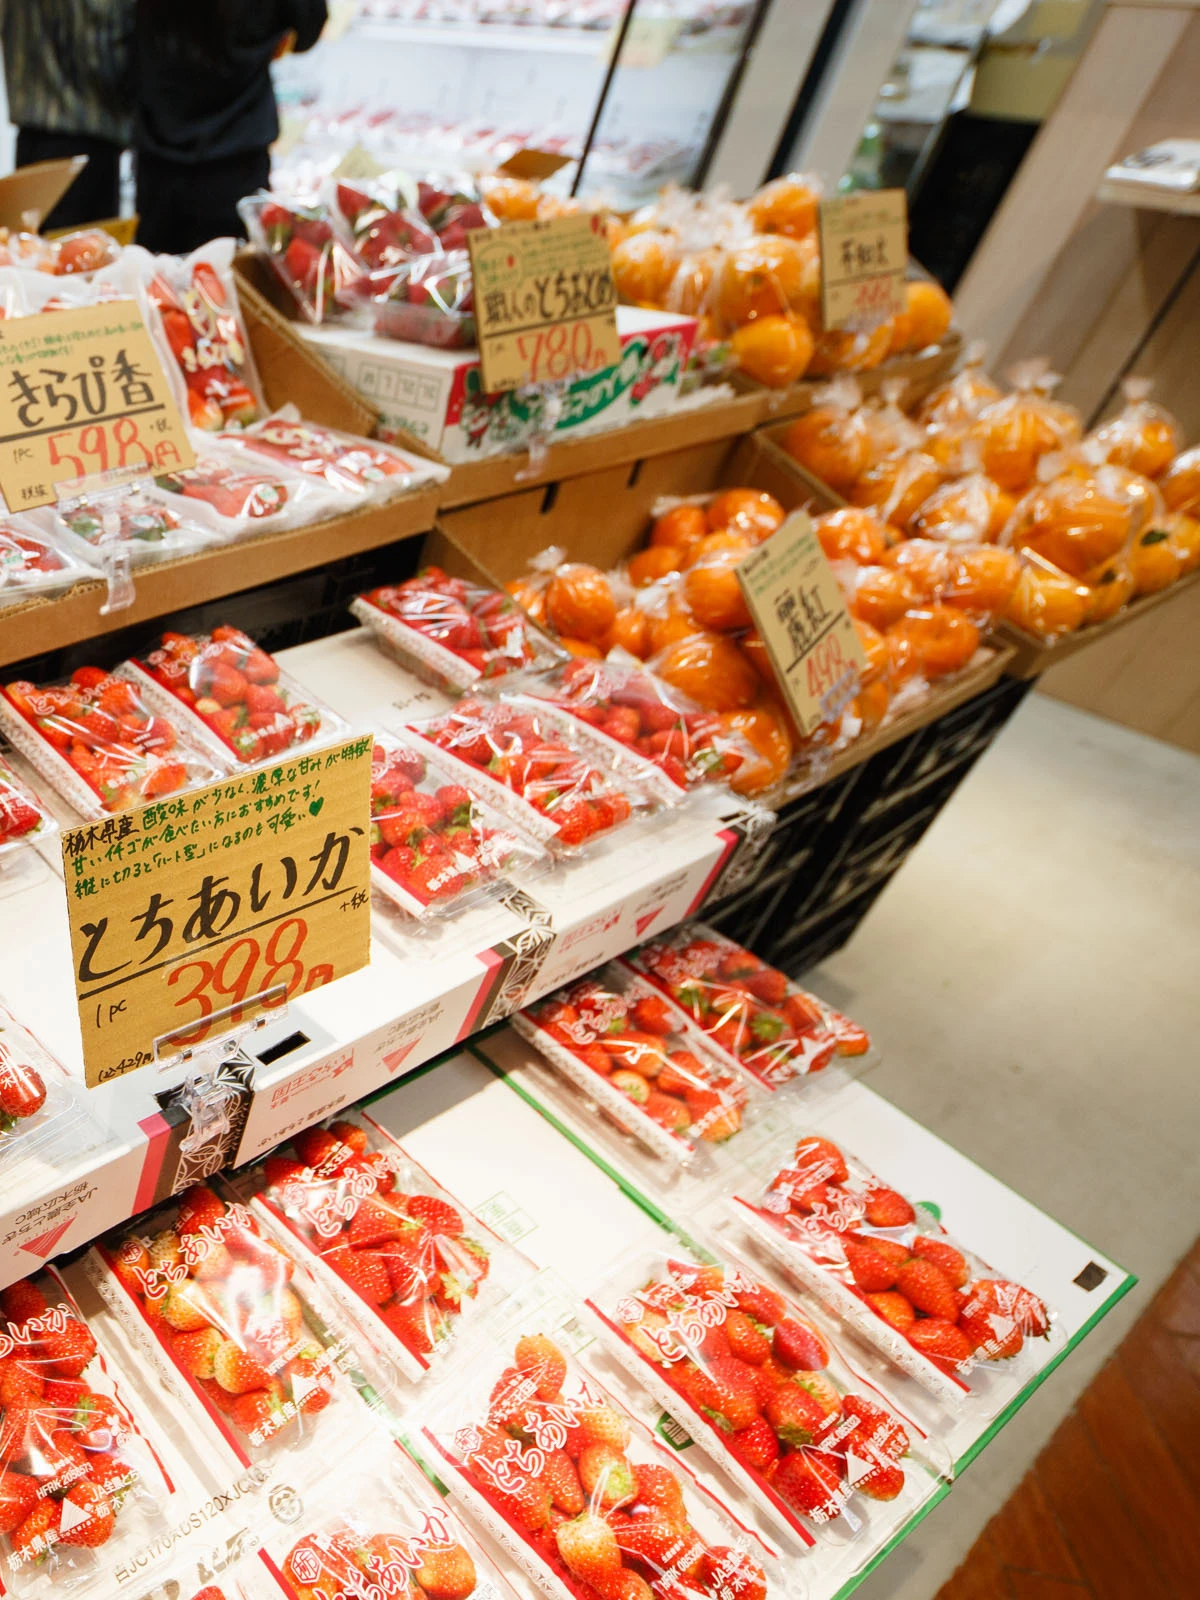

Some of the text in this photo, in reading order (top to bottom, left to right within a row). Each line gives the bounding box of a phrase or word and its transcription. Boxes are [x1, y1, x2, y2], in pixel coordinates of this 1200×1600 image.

[7, 348, 156, 428] きらぴ香
[78, 826, 365, 983] とちあいか
[5, 1527, 61, 1572] 栃木県産
